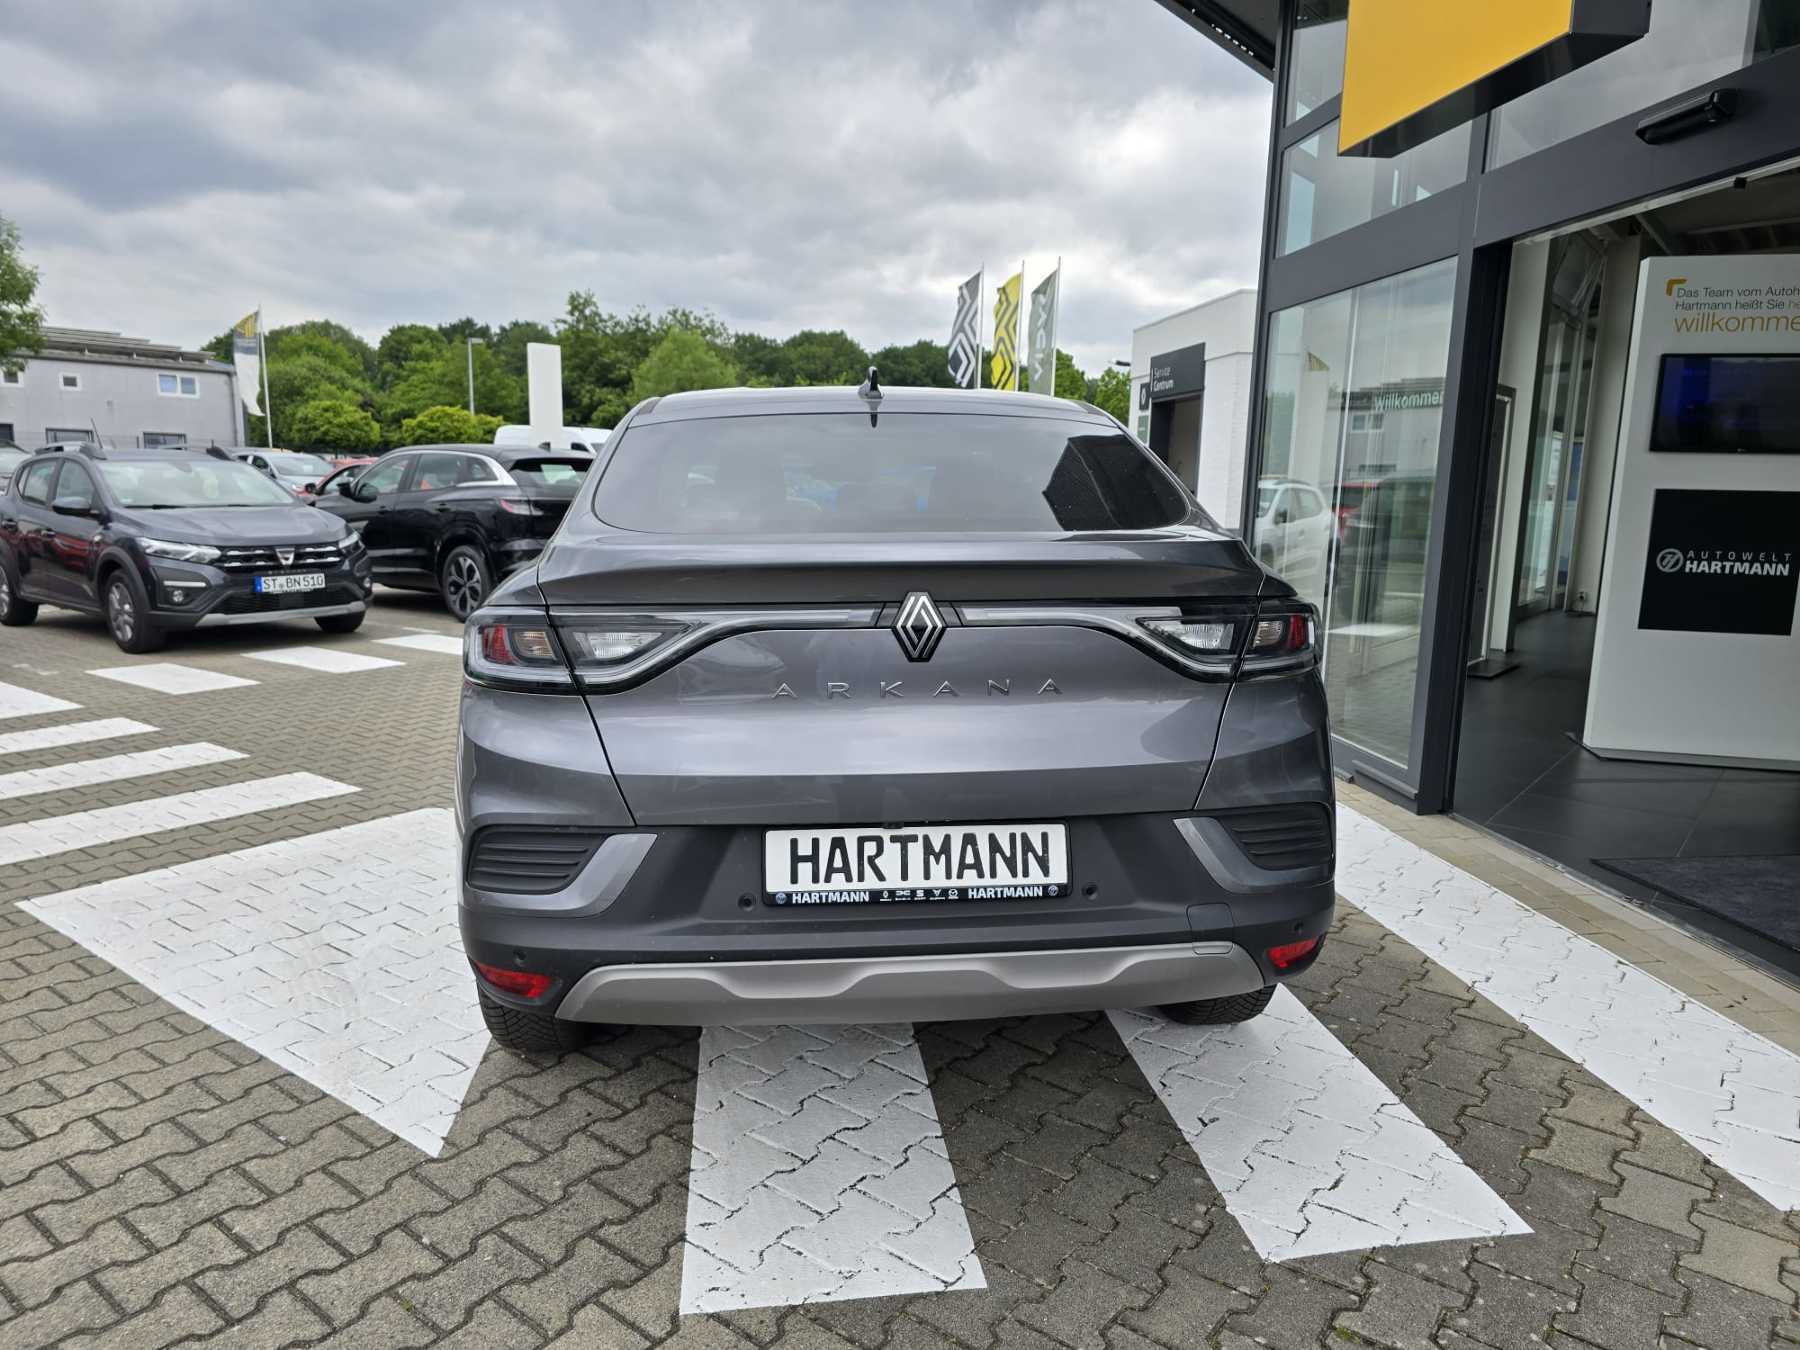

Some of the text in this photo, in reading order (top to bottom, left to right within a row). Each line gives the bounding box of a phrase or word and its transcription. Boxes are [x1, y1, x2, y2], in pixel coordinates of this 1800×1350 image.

[1677, 287, 1699, 298] Das
[1703, 287, 1733, 298] Team
[1737, 288, 1761, 297] vom
[1675, 300, 1732, 311] Hartmann
[1735, 299, 1763, 310] heißt
[1766, 299, 1785, 310] Sie
[1686, 550, 1792, 562] AUTOWELT
[1685, 560, 1790, 576] HARTMANN
[263, 575, 324, 590] ST BN 510
[771, 678, 1062, 699] ARKANA
[789, 831, 1050, 884] HARTMANN
[792, 891, 870, 904] HARTMANN
[967, 886, 1043, 899] HARTMANN
